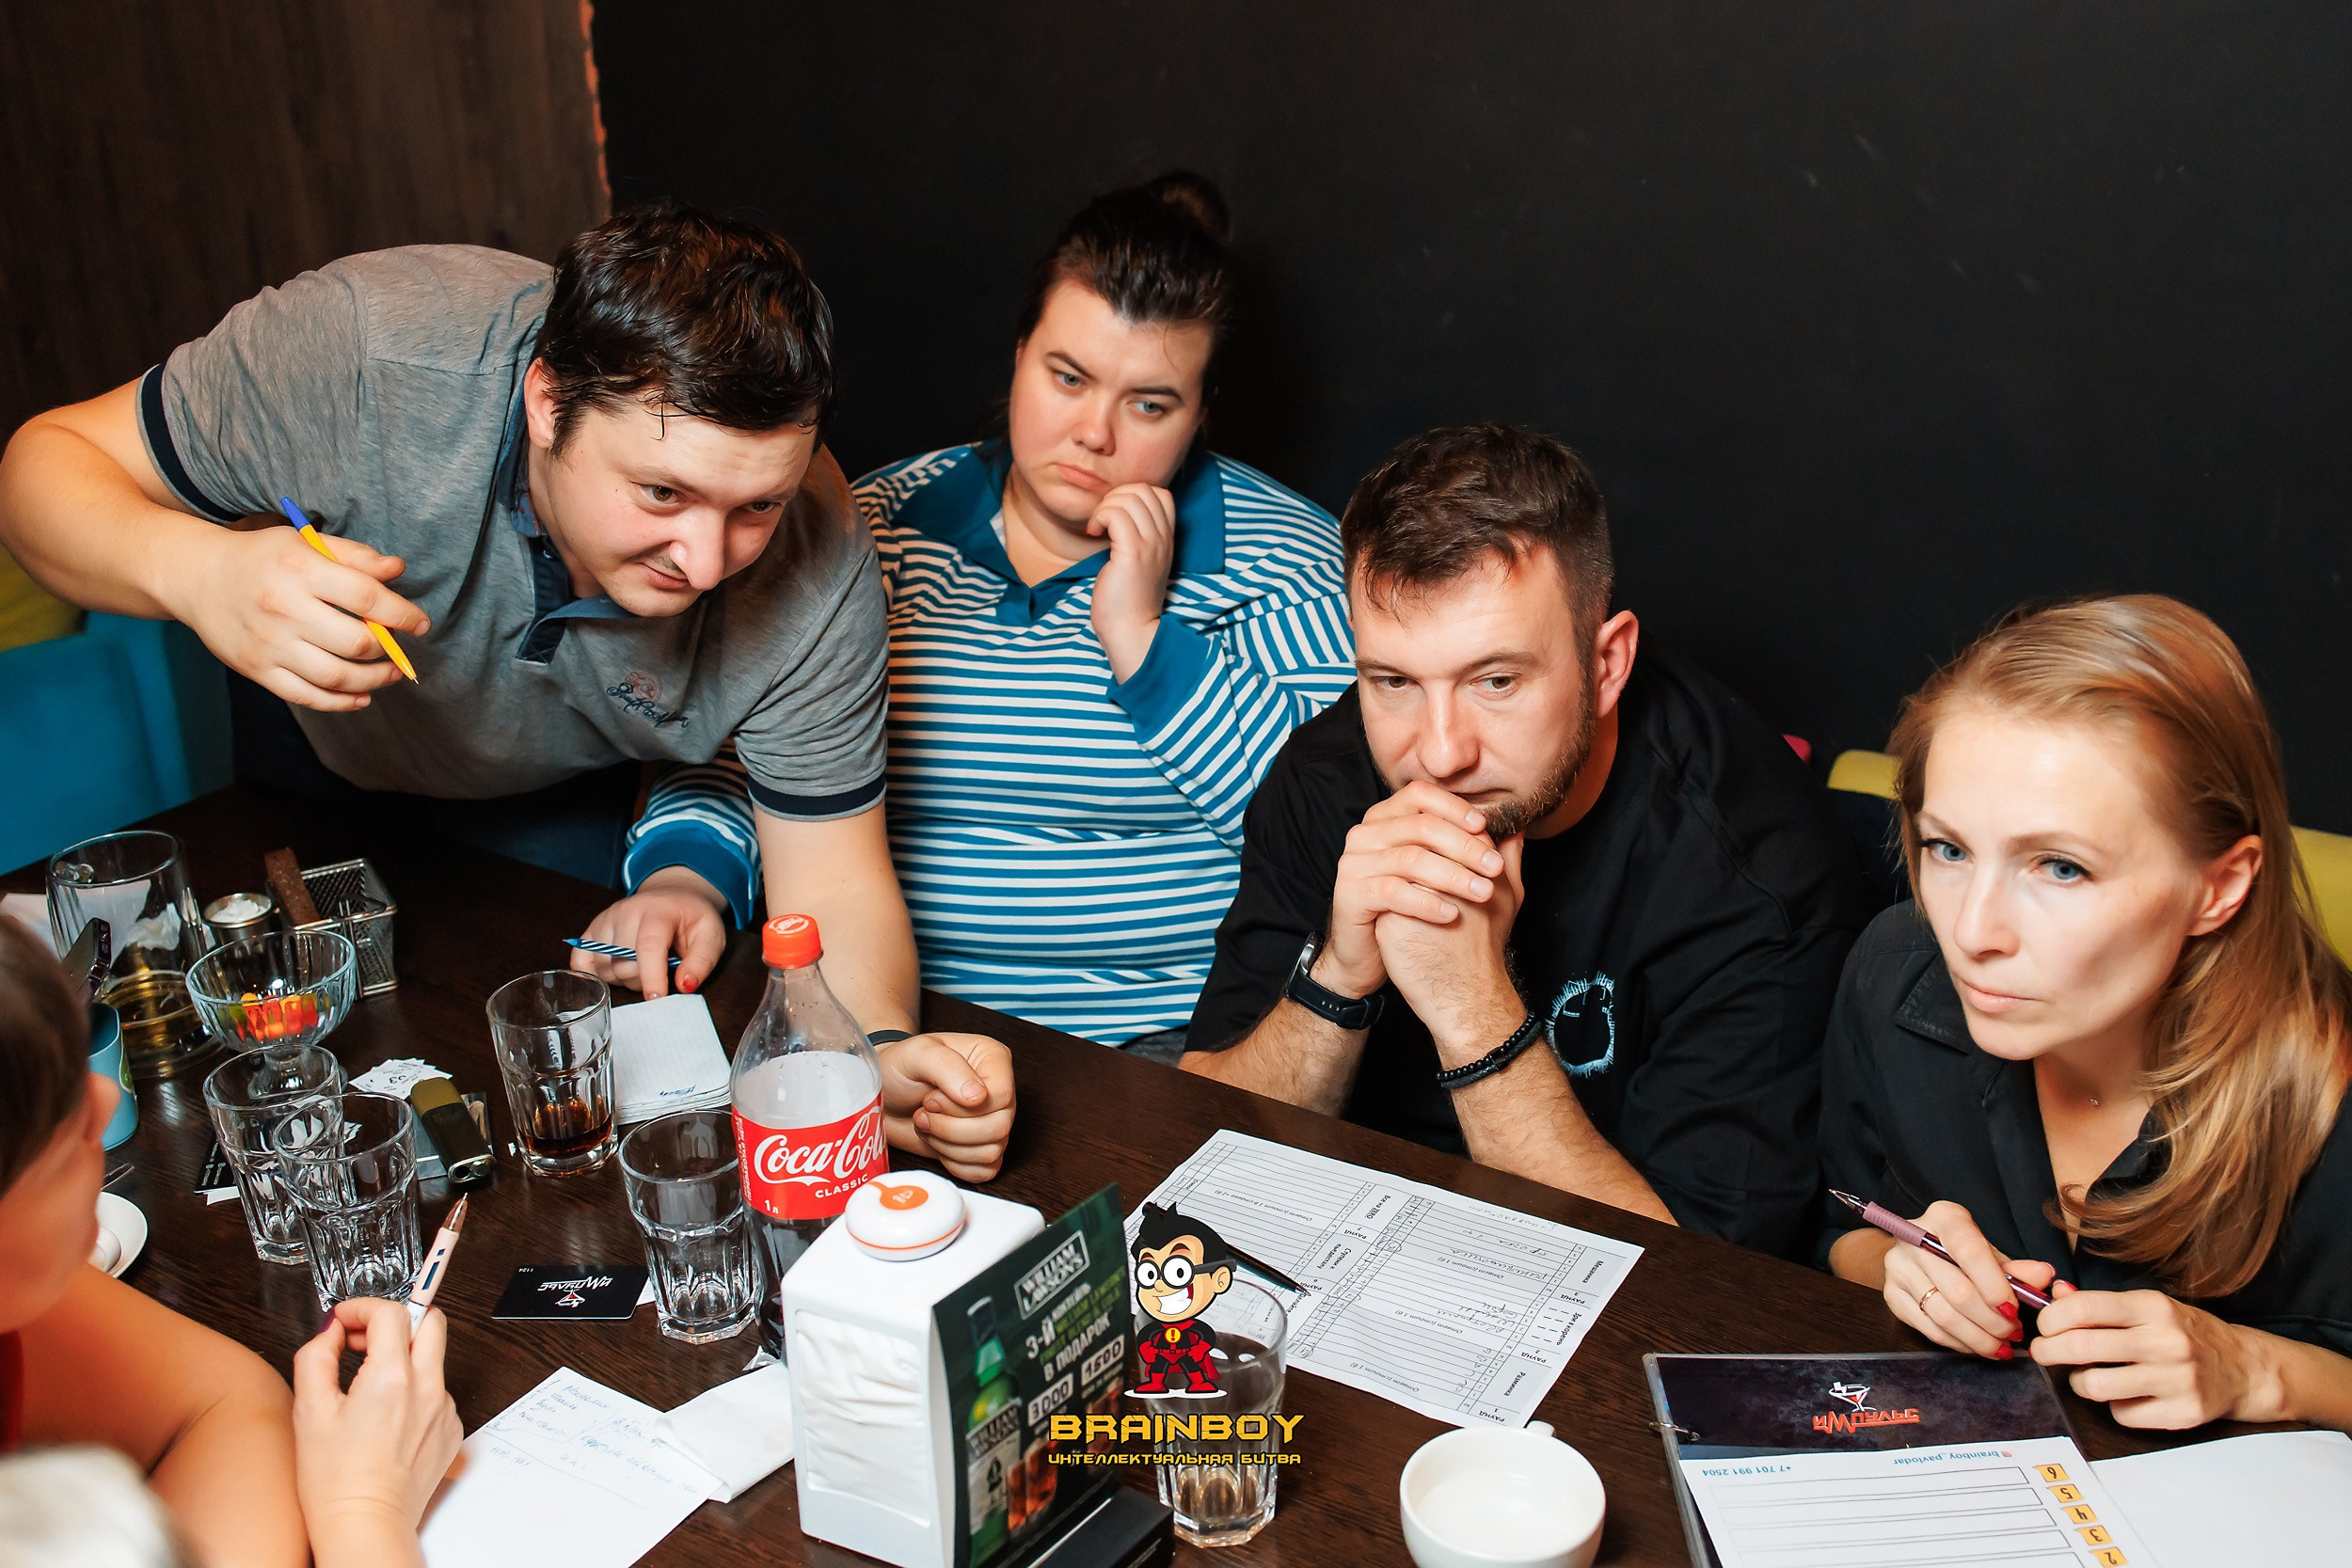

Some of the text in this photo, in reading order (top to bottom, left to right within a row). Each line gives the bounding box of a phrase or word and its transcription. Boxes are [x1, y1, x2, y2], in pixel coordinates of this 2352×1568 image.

[815, 1173, 868, 1198] CLASSIC
[764, 1199, 771, 1212] 1
[1365, 1208, 1380, 1219] ZERO
[1344, 1229, 1367, 1240] РАУНД
[1317, 1244, 1342, 1269] пьедесталу
[1333, 1248, 1352, 1266] Ступени
[1477, 1268, 1504, 1278] Ответ
[1582, 1260, 1604, 1283] Мешанина
[1561, 1294, 1585, 1305] РАУНД
[1571, 1312, 1582, 1323] Зри
[1436, 1322, 1463, 1334] Ответ
[1556, 1325, 1571, 1346] корень
[1043, 1361, 1055, 1383] В
[1056, 1311, 1111, 1372] ПОДАРОК
[1521, 1352, 1547, 1363] РАУНД
[1393, 1380, 1420, 1392] Ответ
[1504, 1372, 1526, 1397] Разминка
[1032, 1380, 1070, 1420] 3000
[1479, 1411, 1505, 1422] РАУНД
[1812, 1408, 1920, 1433] ИМПУЛЬС
[1894, 1450, 2000, 1465] brainboy_pavlodar
[1702, 1468, 1729, 1477] 2504
[2047, 1466, 2058, 1480] 6
[2060, 1487, 2074, 1499] 5
[2074, 1508, 2088, 1520] 4
[2090, 1528, 2104, 1542] 3
[2104, 1552, 2117, 1564] 2
